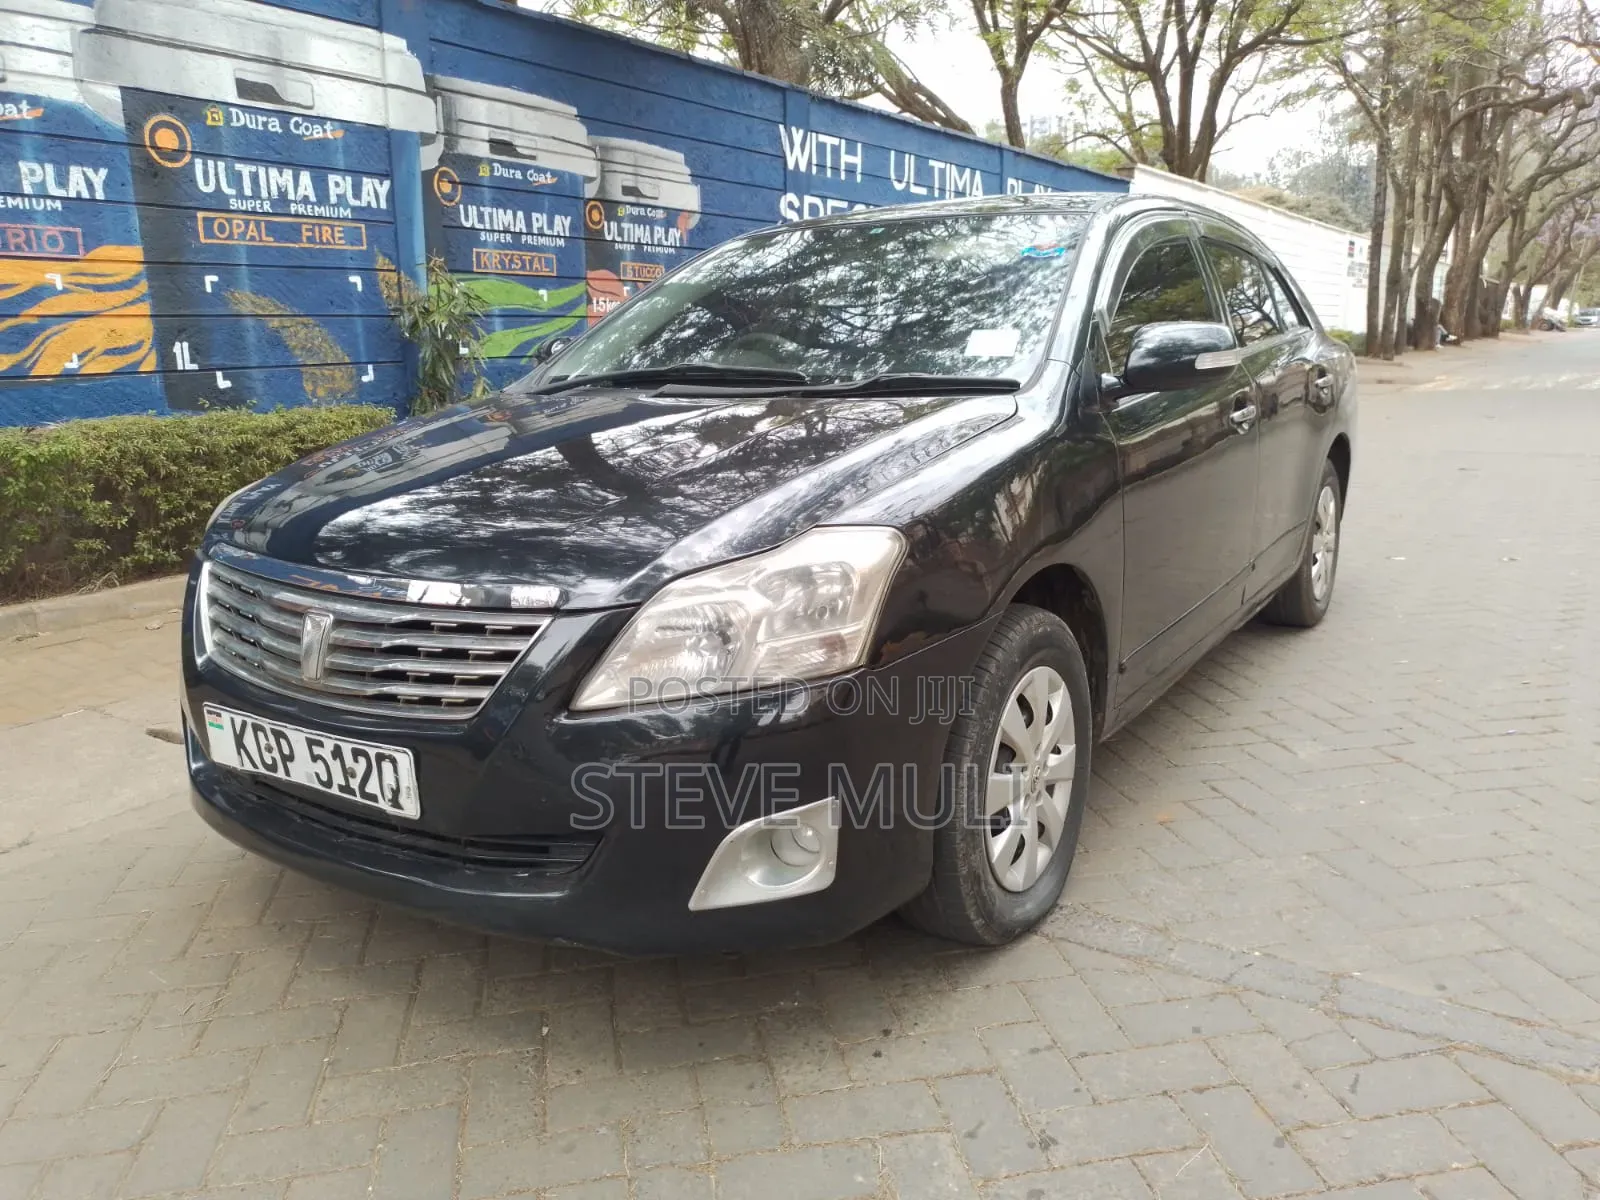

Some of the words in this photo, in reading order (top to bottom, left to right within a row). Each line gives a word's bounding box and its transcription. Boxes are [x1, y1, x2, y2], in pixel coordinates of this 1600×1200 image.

[229, 108, 282, 134] Dura
[289, 116, 336, 139] Coat
[492, 163, 522, 180] Dura
[527, 169, 553, 184] Coat
[779, 124, 862, 183] WITH
[890, 150, 983, 199] ULTIMA
[18, 160, 108, 200] PLAY
[194, 158, 316, 203] ULTIMA
[328, 174, 391, 209] PLAY
[229, 199, 272, 212] SUPER
[290, 204, 352, 219] PREMIUM
[459, 204, 526, 233] ULTIMA
[532, 212, 571, 236] PLAY
[626, 205, 646, 216] Dura
[0, 228, 64, 252] RIO
[213, 218, 274, 242] OPAL
[302, 224, 345, 245] FIRE
[480, 231, 513, 243] SUPER
[521, 234, 565, 248] PREMIUM
[604, 221, 652, 243] ULTIMA
[654, 226, 682, 246] PLAY
[615, 243, 635, 252] SUPER
[643, 245, 675, 254] PREMIUM
[480, 252, 550, 272] KRYSTAL
[230, 716, 292, 778] KCP
[305, 737, 404, 810] 512Q
